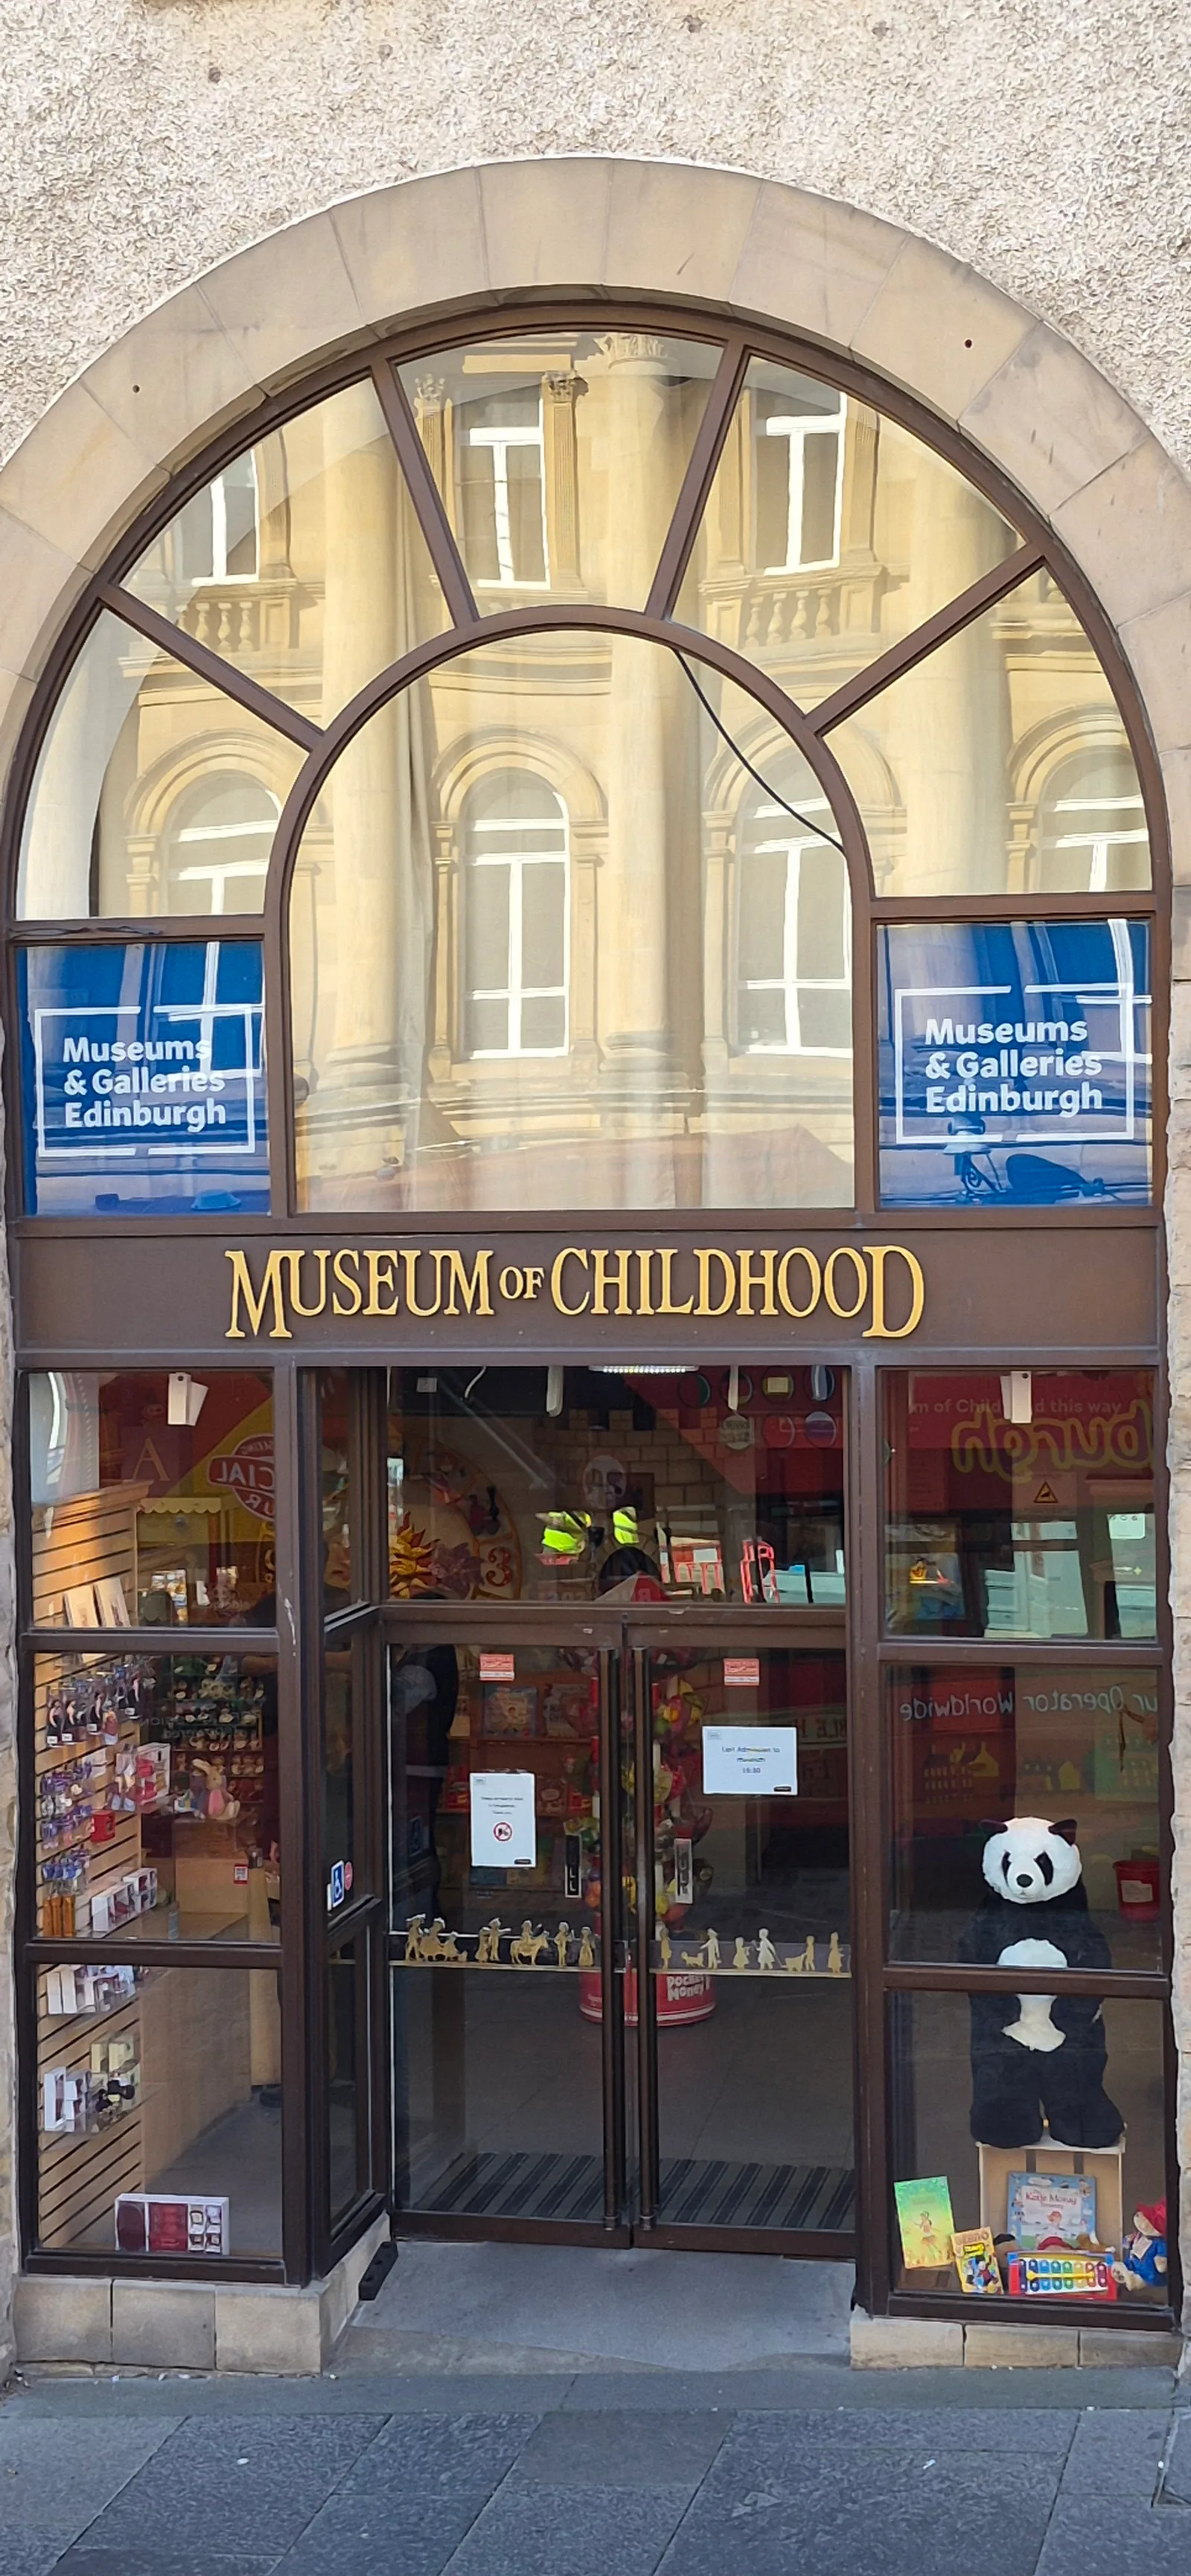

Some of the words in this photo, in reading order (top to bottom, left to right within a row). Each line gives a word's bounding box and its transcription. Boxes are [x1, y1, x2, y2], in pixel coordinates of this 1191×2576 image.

[925, 1019, 1088, 1045] Museums
[63, 1037, 211, 1063] Museums
[925, 1052, 951, 1080] &
[957, 1048, 1103, 1078] Galleries
[64, 1069, 87, 1095] &
[92, 1066, 226, 1095] Galleries
[65, 1098, 226, 1133] Edinburgh
[926, 1081, 1103, 1118] Edinburgh
[225, 1249, 495, 1339] MUSEUM
[499, 1266, 545, 1300] OF
[551, 1245, 925, 1339] CHILDHOOD
[934, 1399, 951, 1413] of
[1050, 1399, 1083, 1413] this
[1088, 1402, 1121, 1414] way
[485, 1547, 514, 1587] 3
